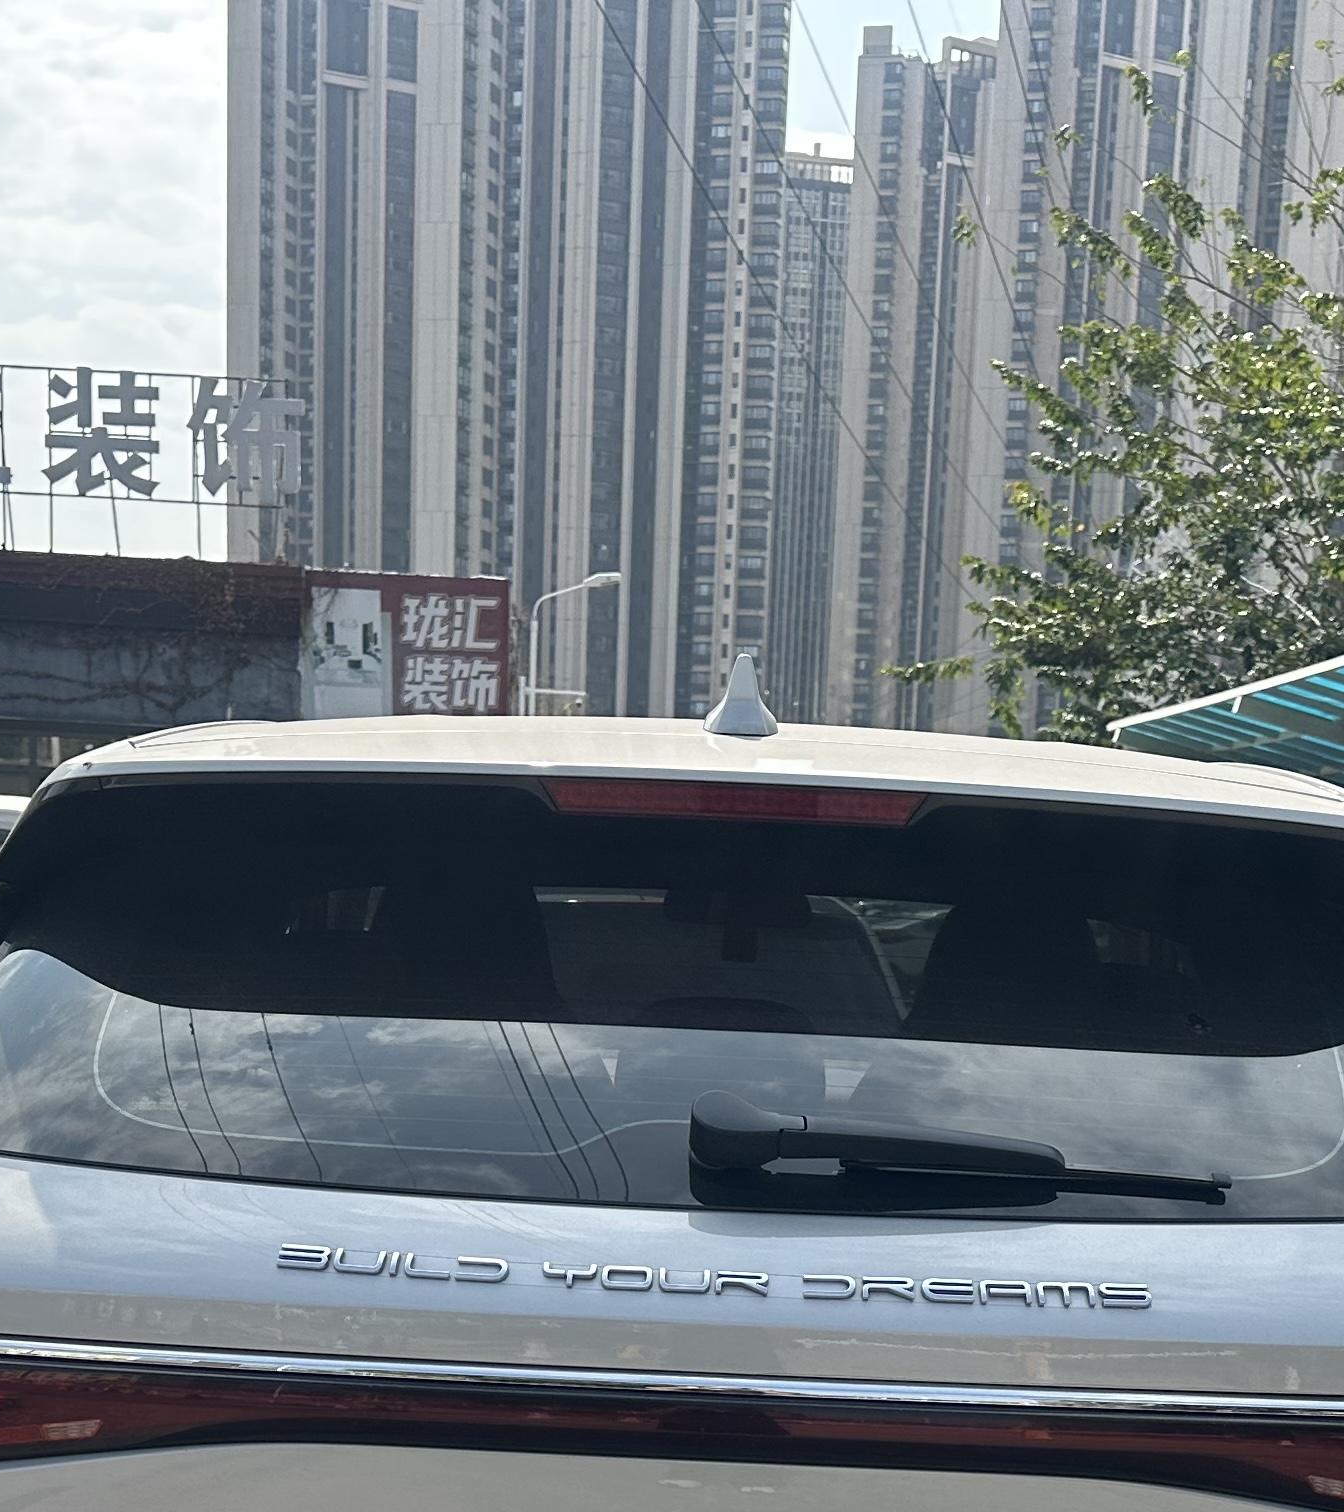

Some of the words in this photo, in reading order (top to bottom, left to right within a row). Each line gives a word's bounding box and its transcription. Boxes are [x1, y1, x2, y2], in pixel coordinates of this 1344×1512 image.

[401, 593, 500, 652] 珑汇
[403, 653, 499, 715] 装饰
[277, 1243, 510, 1283] BUILD
[543, 1261, 768, 1297] YOUR
[803, 1274, 1152, 1309] DREAMS
